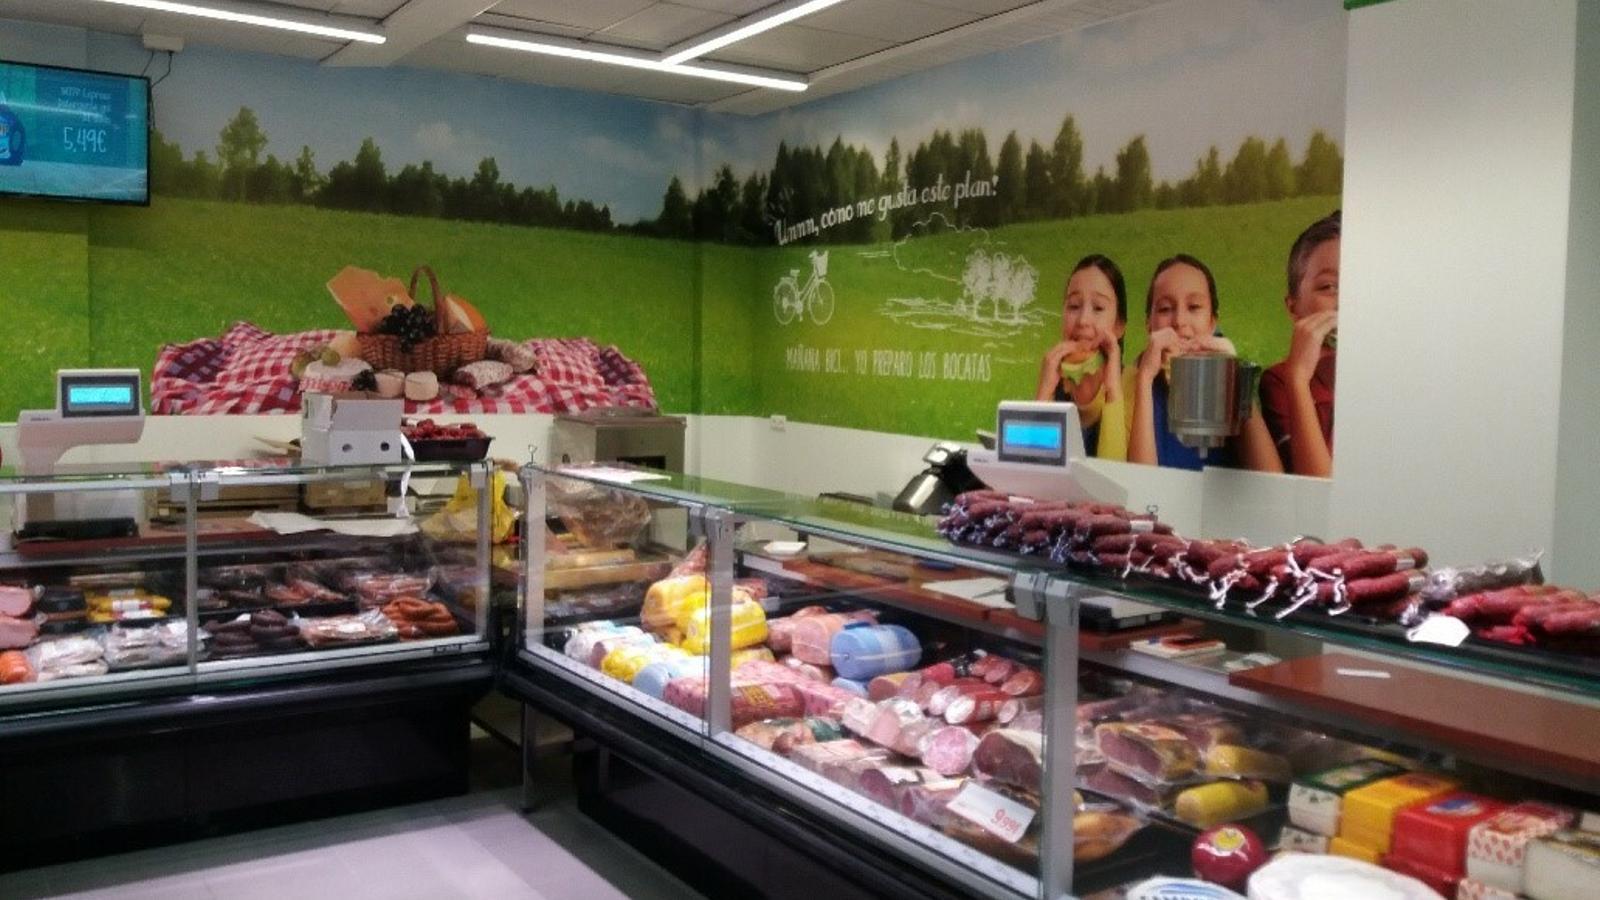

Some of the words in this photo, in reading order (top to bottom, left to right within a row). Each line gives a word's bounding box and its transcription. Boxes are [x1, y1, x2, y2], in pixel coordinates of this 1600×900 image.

[63, 126, 106, 153] 5,49€
[857, 197, 875, 218] me
[878, 179, 917, 222] gusta
[921, 173, 951, 203] este
[954, 169, 999, 209] plan!
[786, 344, 820, 372] MAÑANA
[854, 349, 867, 374] YO
[872, 349, 913, 377] PREPARO
[919, 351, 936, 379] LOS
[943, 352, 992, 382] BOCATAS
